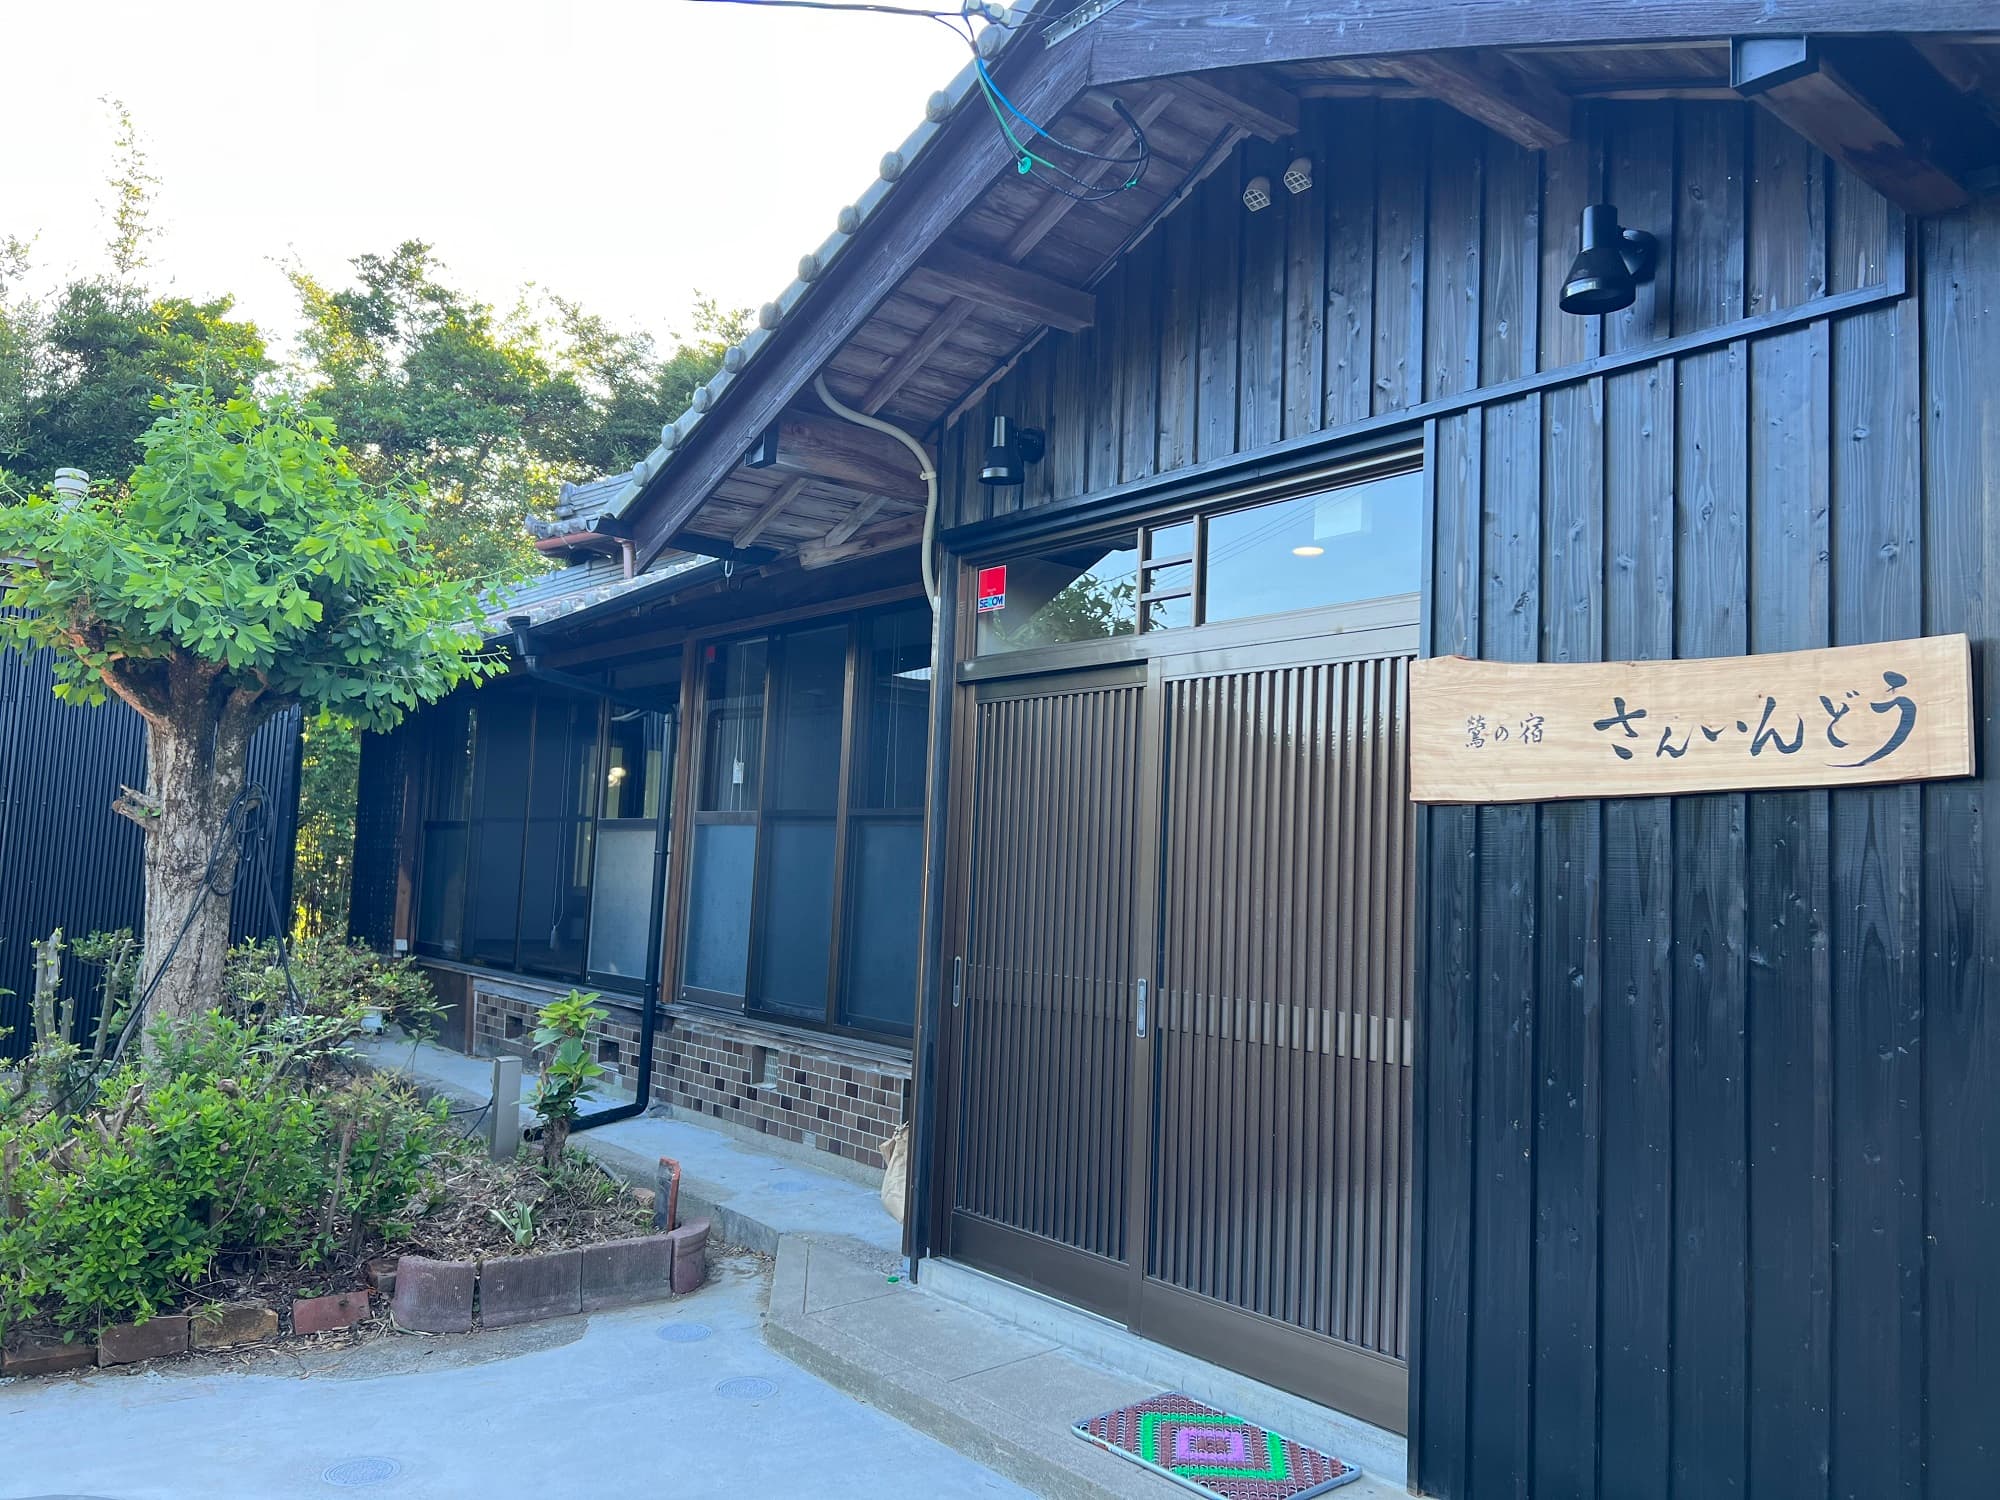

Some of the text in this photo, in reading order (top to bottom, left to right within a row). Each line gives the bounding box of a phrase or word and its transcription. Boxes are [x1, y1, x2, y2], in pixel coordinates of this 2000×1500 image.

[979, 595, 1003, 608] SECOM
[1593, 671, 1917, 768] さんいんどう
